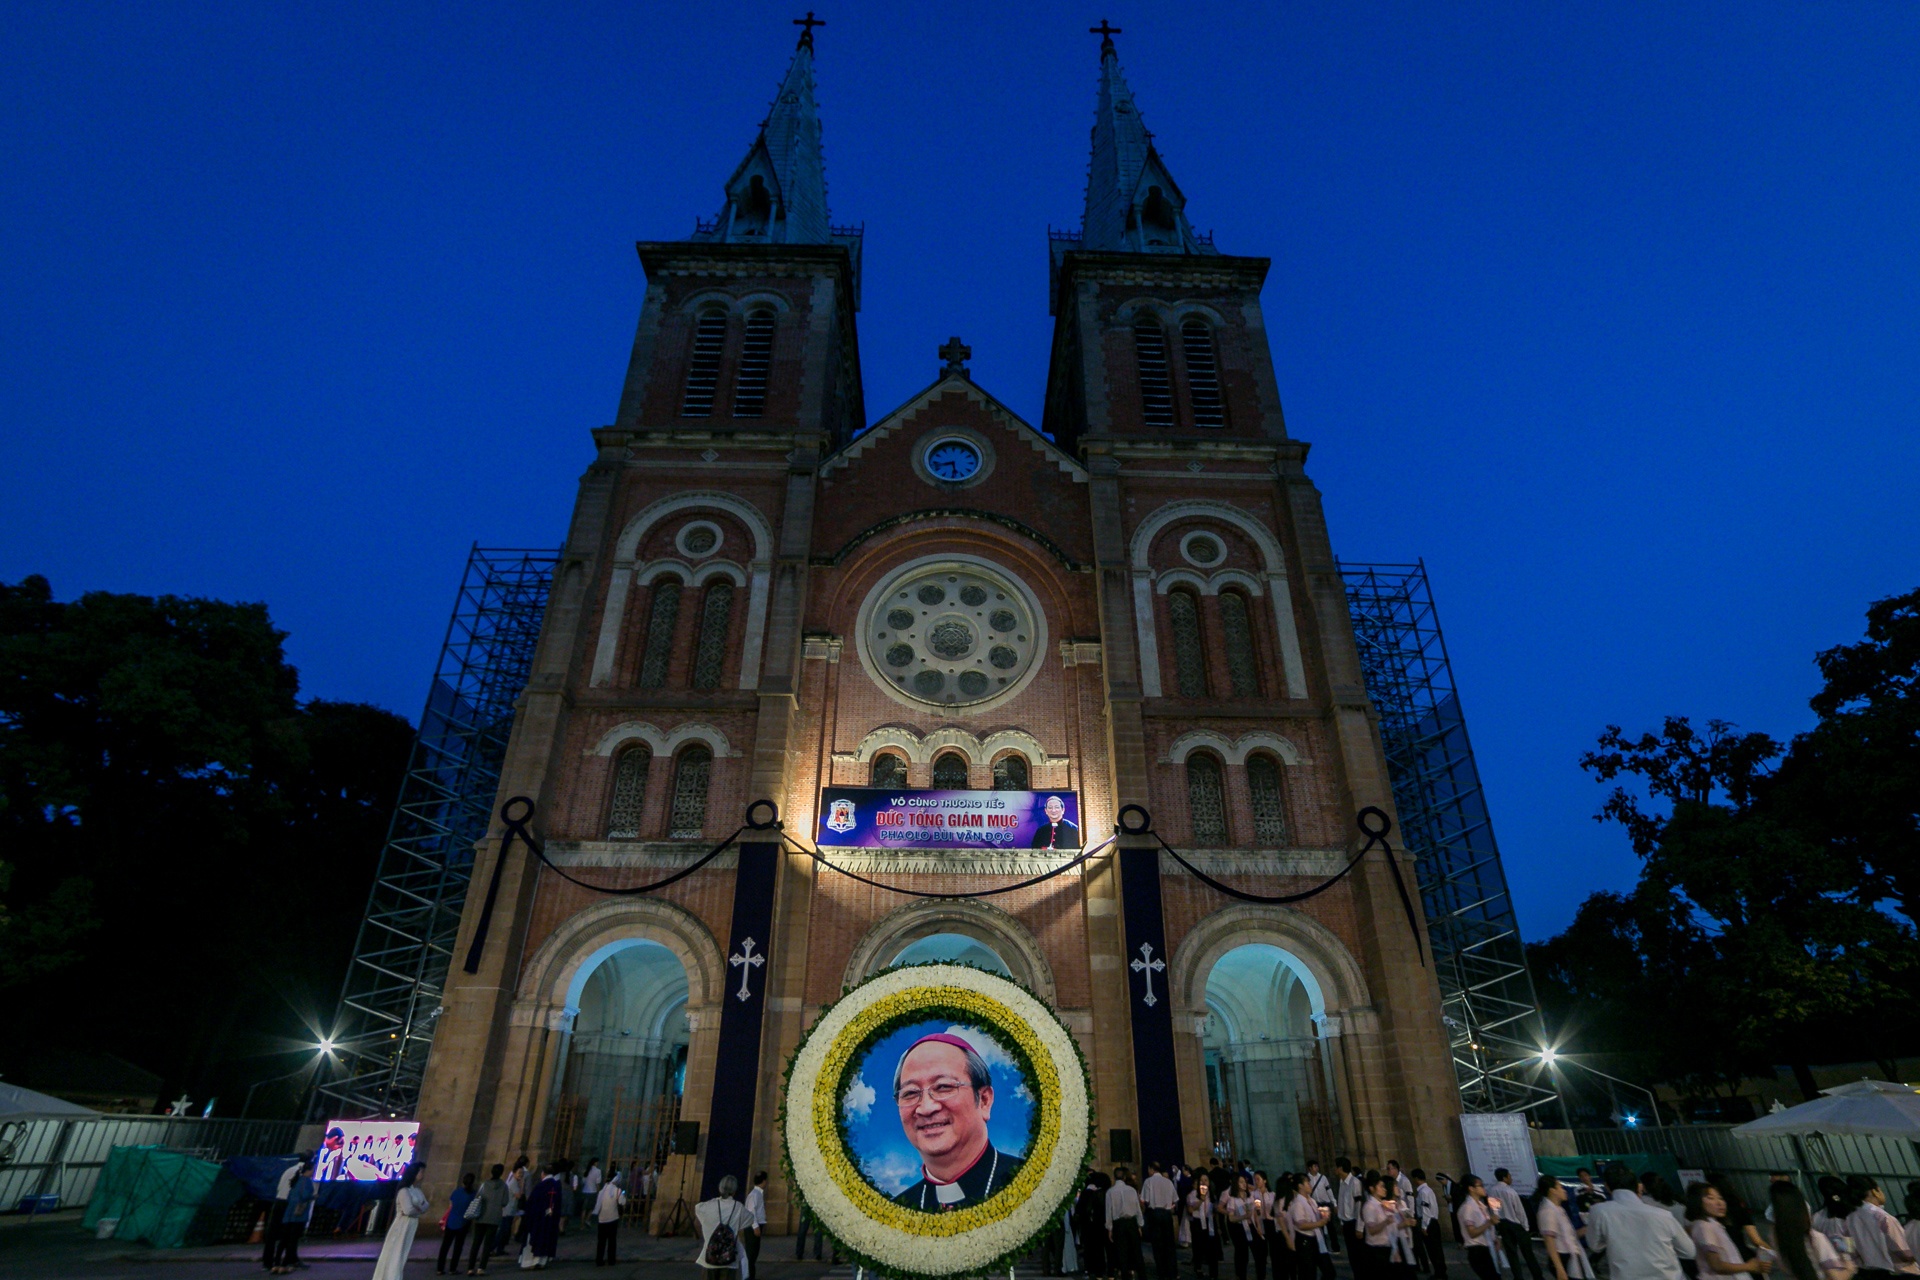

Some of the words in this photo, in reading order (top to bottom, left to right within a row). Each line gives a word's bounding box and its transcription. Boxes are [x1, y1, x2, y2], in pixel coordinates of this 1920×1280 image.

[891, 797, 906, 807] VÔ
[908, 797, 938, 808] CÙNG
[876, 809, 904, 826] ĐỨC
[947, 811, 983, 828] GIÁM
[987, 814, 1018, 831] MỤC
[933, 829, 952, 841] BÙI
[985, 832, 1014, 844] ĐỌC
